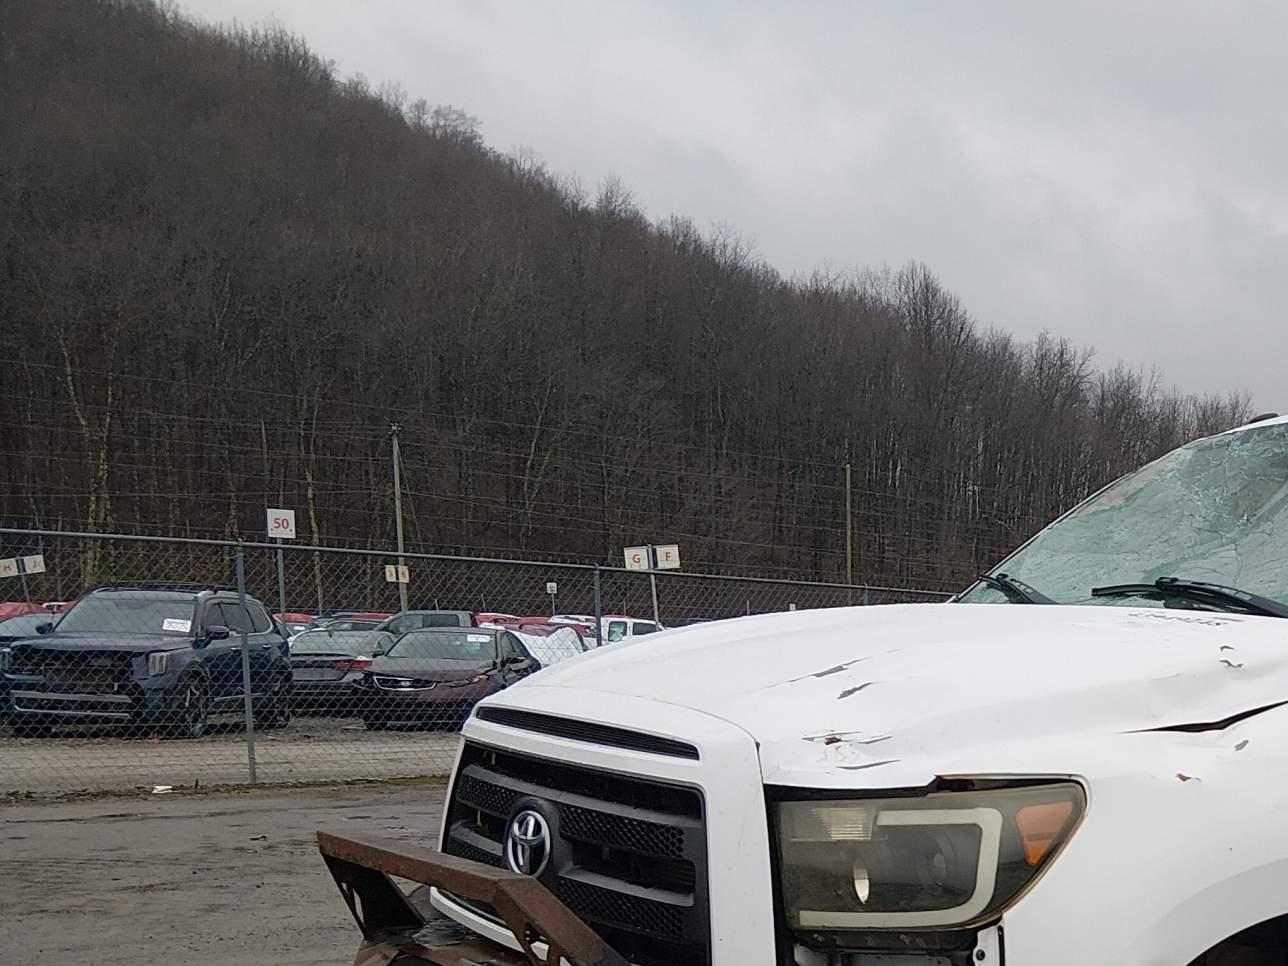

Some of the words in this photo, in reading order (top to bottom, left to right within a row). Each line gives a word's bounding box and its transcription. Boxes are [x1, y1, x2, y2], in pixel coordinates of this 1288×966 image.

[273, 517, 289, 530] 50
[632, 553, 641, 564] G
[665, 551, 672, 562] F
